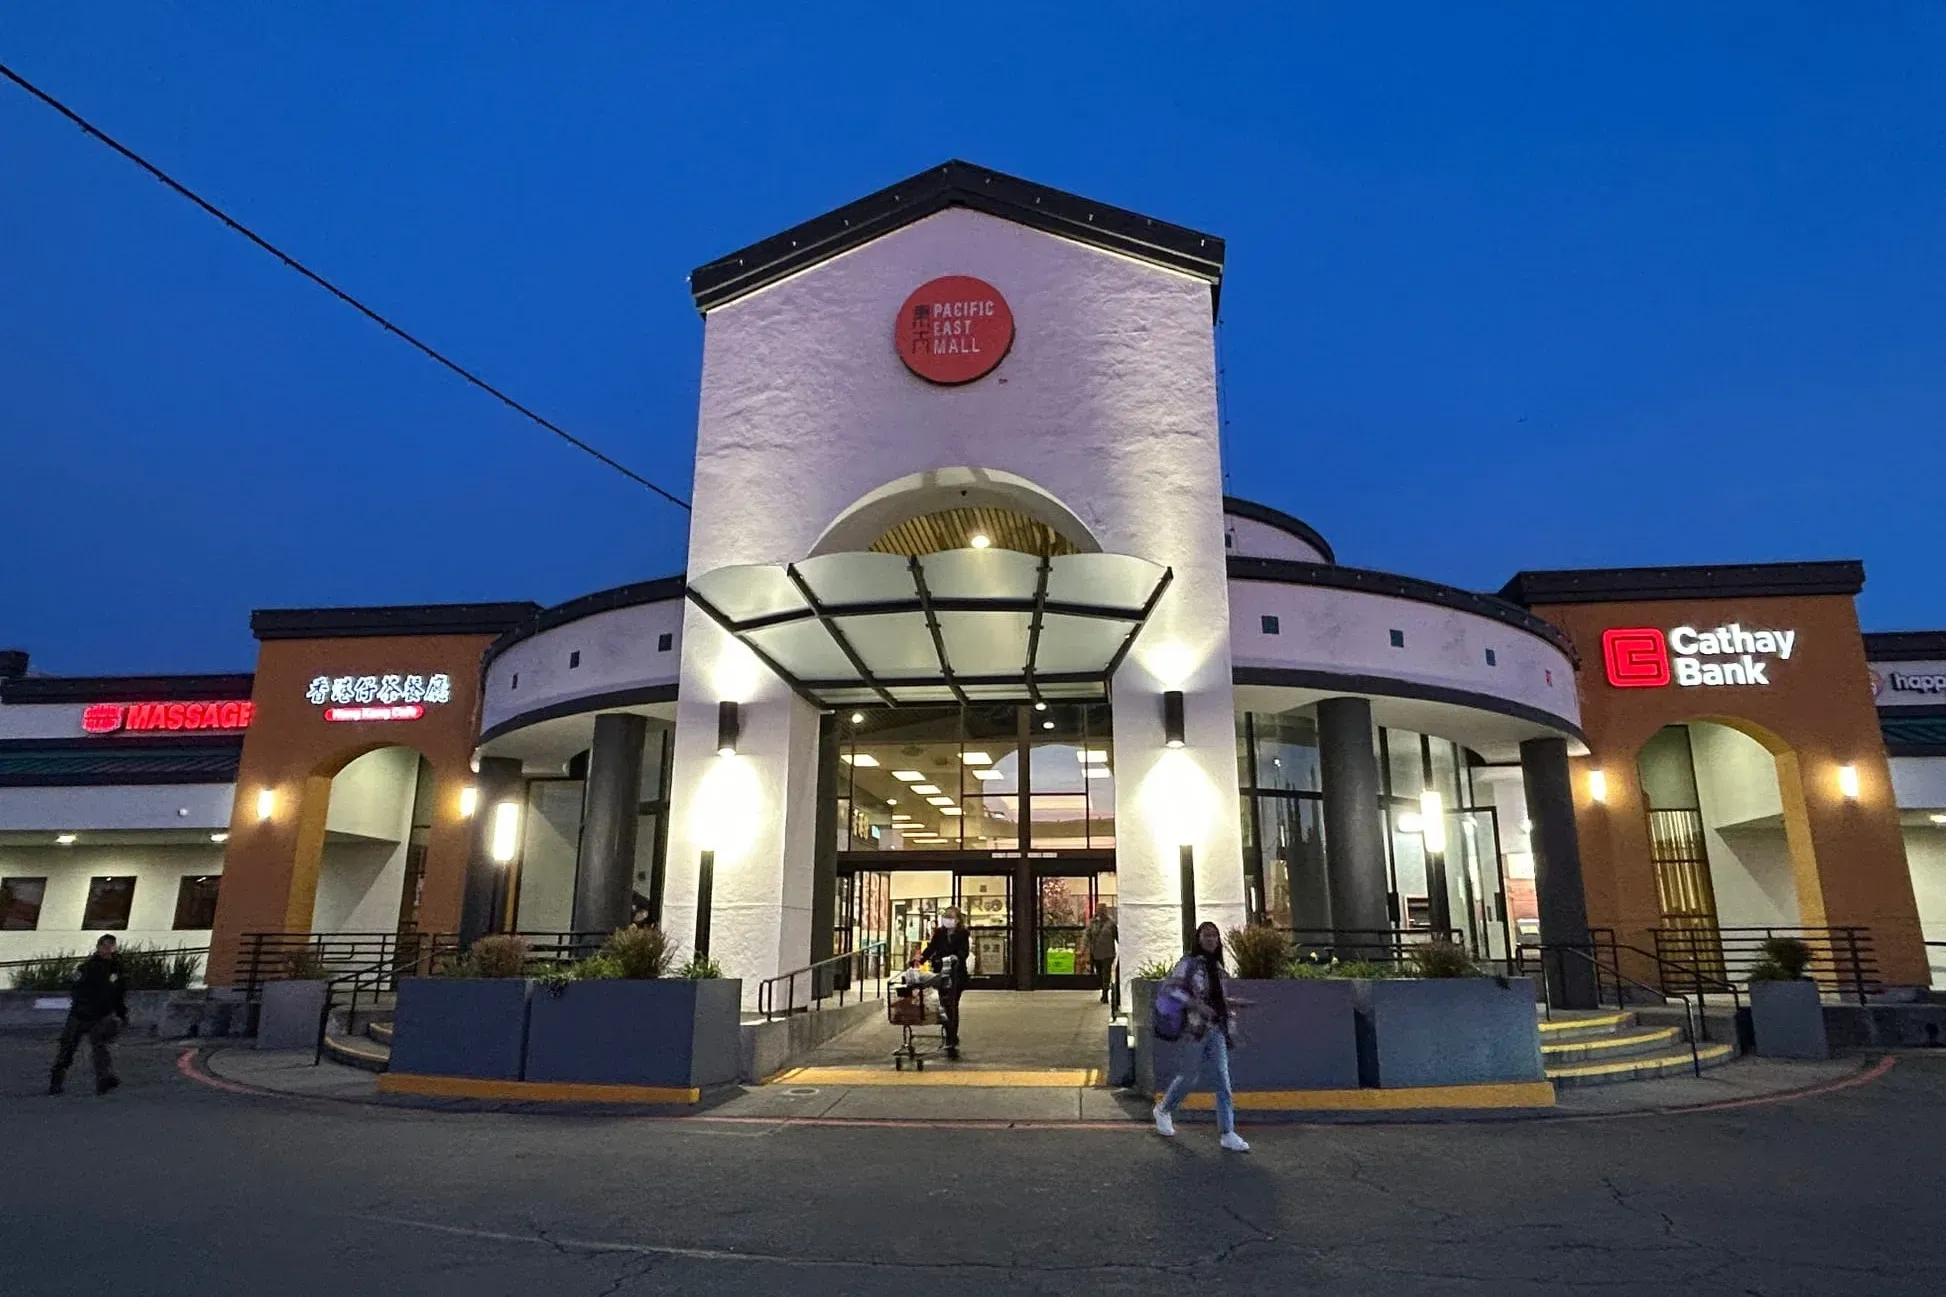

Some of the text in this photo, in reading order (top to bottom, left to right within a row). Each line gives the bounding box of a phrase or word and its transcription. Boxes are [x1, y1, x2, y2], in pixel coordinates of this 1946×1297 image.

[933, 301, 995, 318] PACIFIC
[933, 320, 972, 336] EAST
[933, 338, 980, 355] MALL
[1671, 623, 1795, 660] Cathay
[1674, 655, 1770, 686] Bank
[125, 702, 252, 730] MASSAGE
